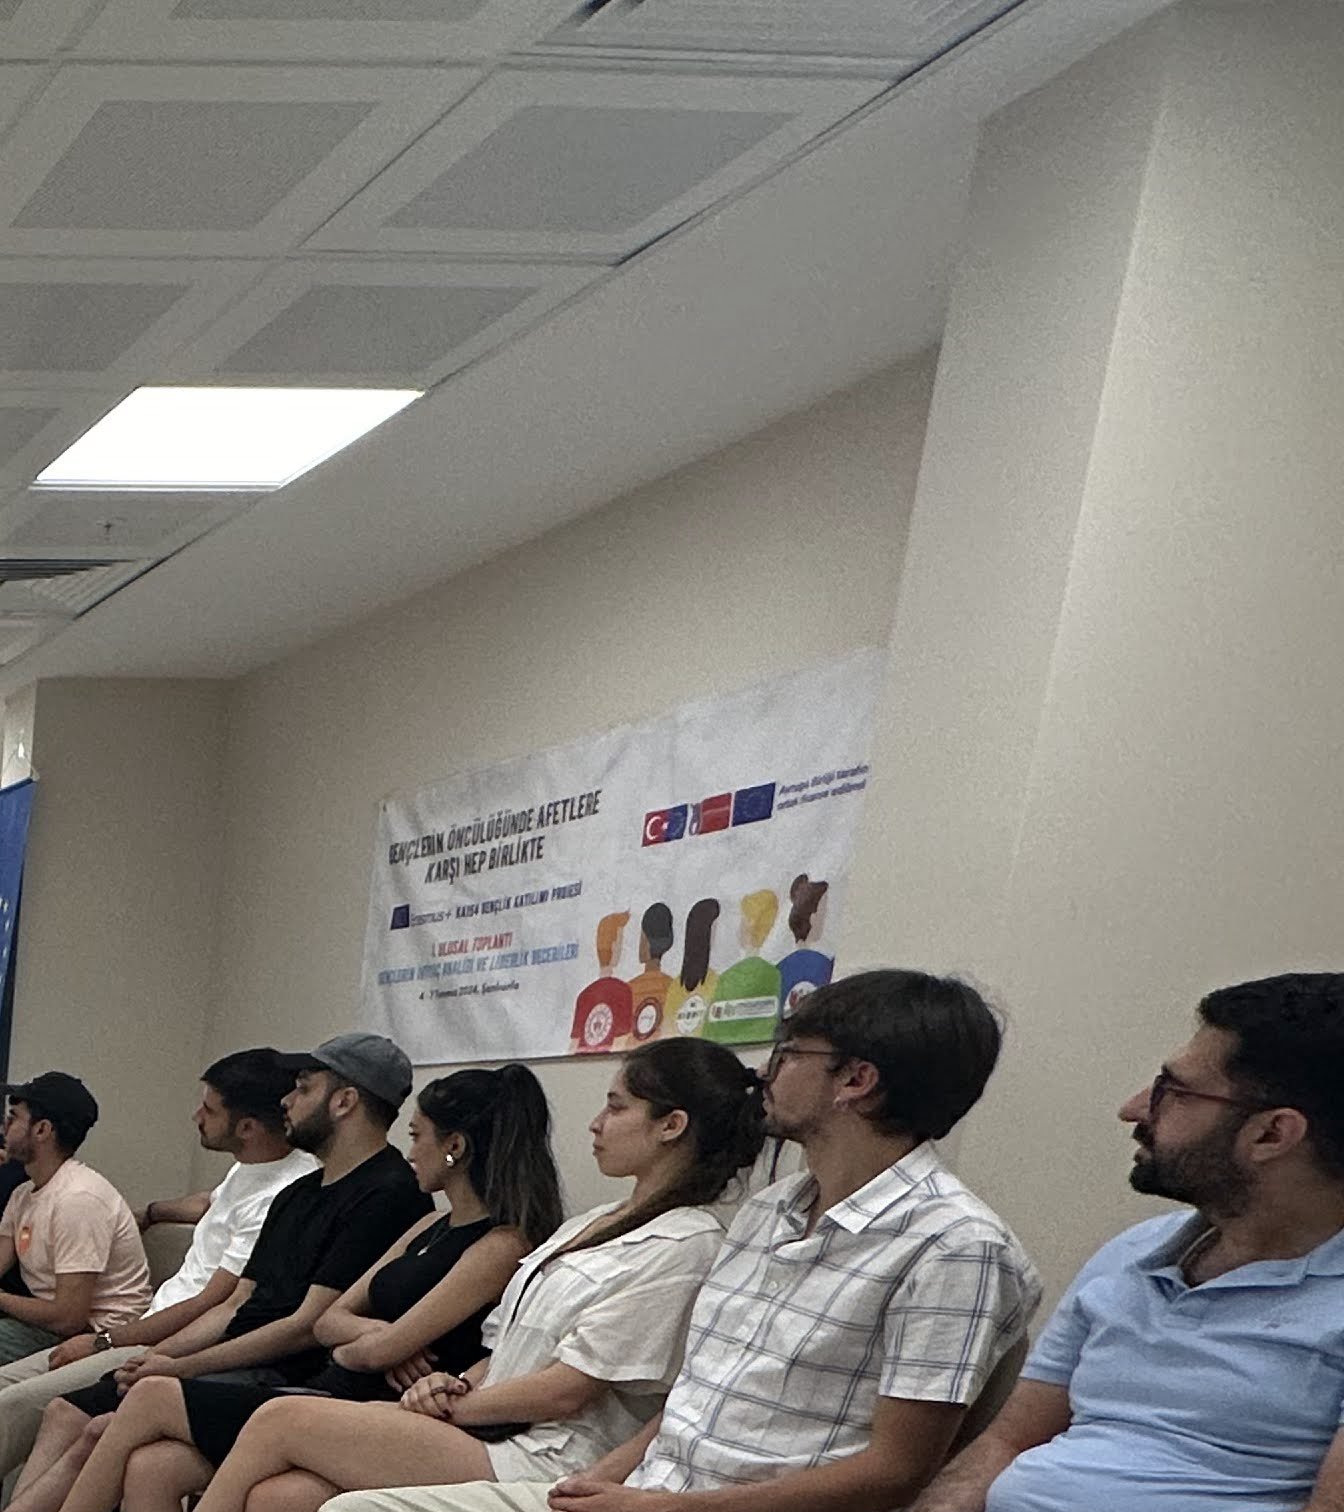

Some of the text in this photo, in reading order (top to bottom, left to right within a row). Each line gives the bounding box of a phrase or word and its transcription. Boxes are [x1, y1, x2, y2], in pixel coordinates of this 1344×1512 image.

[537, 789, 603, 829] AFETLERE
[424, 835, 546, 886] KARŞI HEP BİRLİKTE
